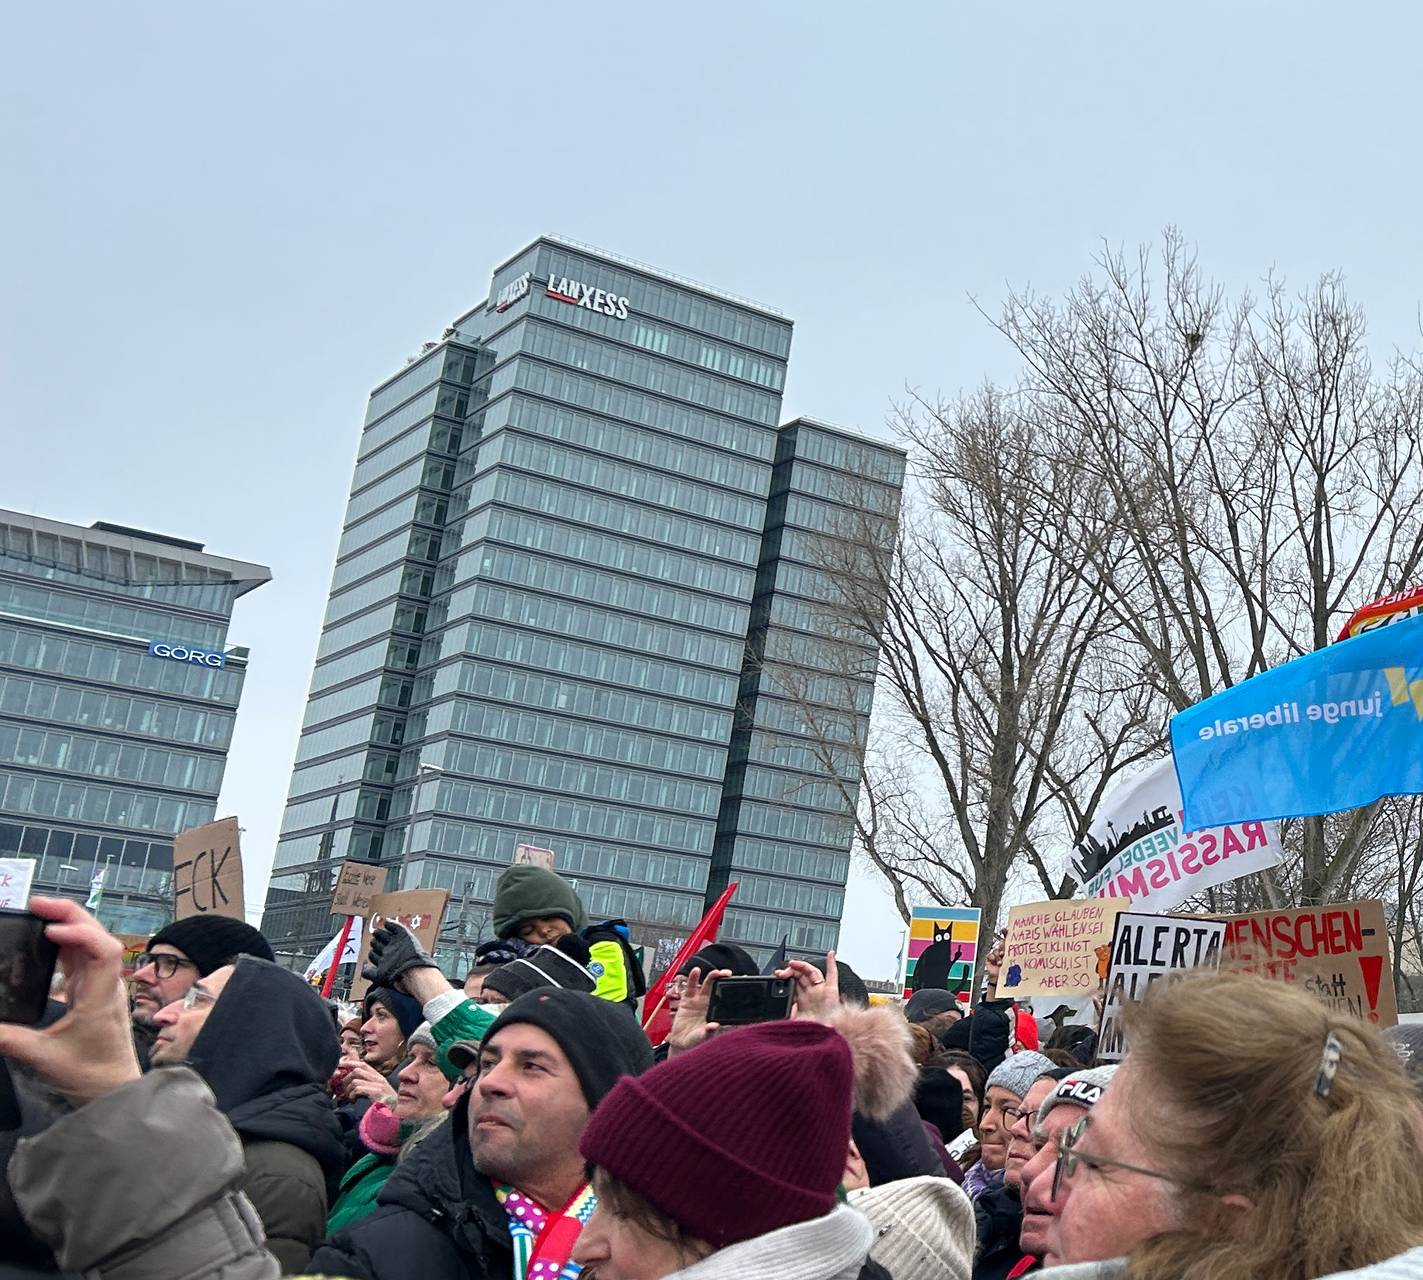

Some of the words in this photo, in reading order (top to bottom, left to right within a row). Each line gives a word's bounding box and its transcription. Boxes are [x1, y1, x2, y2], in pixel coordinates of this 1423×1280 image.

[547, 273, 630, 320] LANXESS
[154, 644, 222, 667] GÖRG
[1013, 914, 1050, 929] MANCHE
[1055, 907, 1104, 922] GLAUBEN
[1011, 927, 1040, 940] NAZIS
[1114, 925, 1220, 968] ALERTA
[1040, 975, 1069, 988] ABER
[1072, 972, 1091, 988] SO
[1058, 1081, 1101, 1104] FILA
